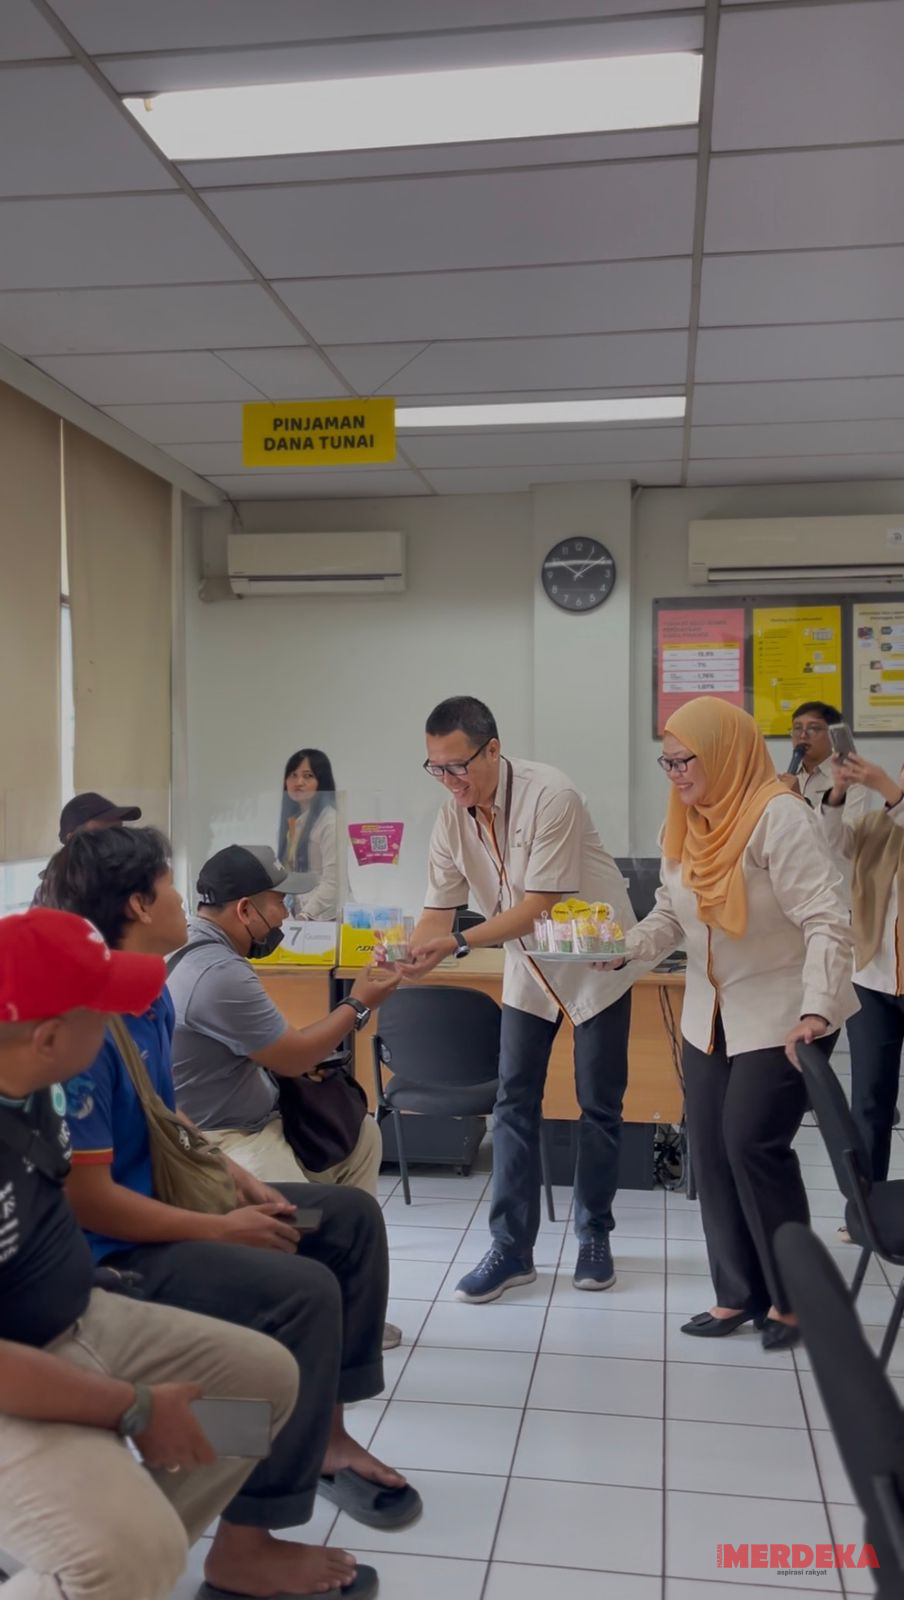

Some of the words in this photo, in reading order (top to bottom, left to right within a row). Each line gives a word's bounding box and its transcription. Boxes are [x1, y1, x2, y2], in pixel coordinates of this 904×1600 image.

[273, 415, 365, 431] PINJAMAN
[264, 437, 314, 451] DANA
[319, 434, 375, 449] TUNAI
[289, 926, 303, 946] 7
